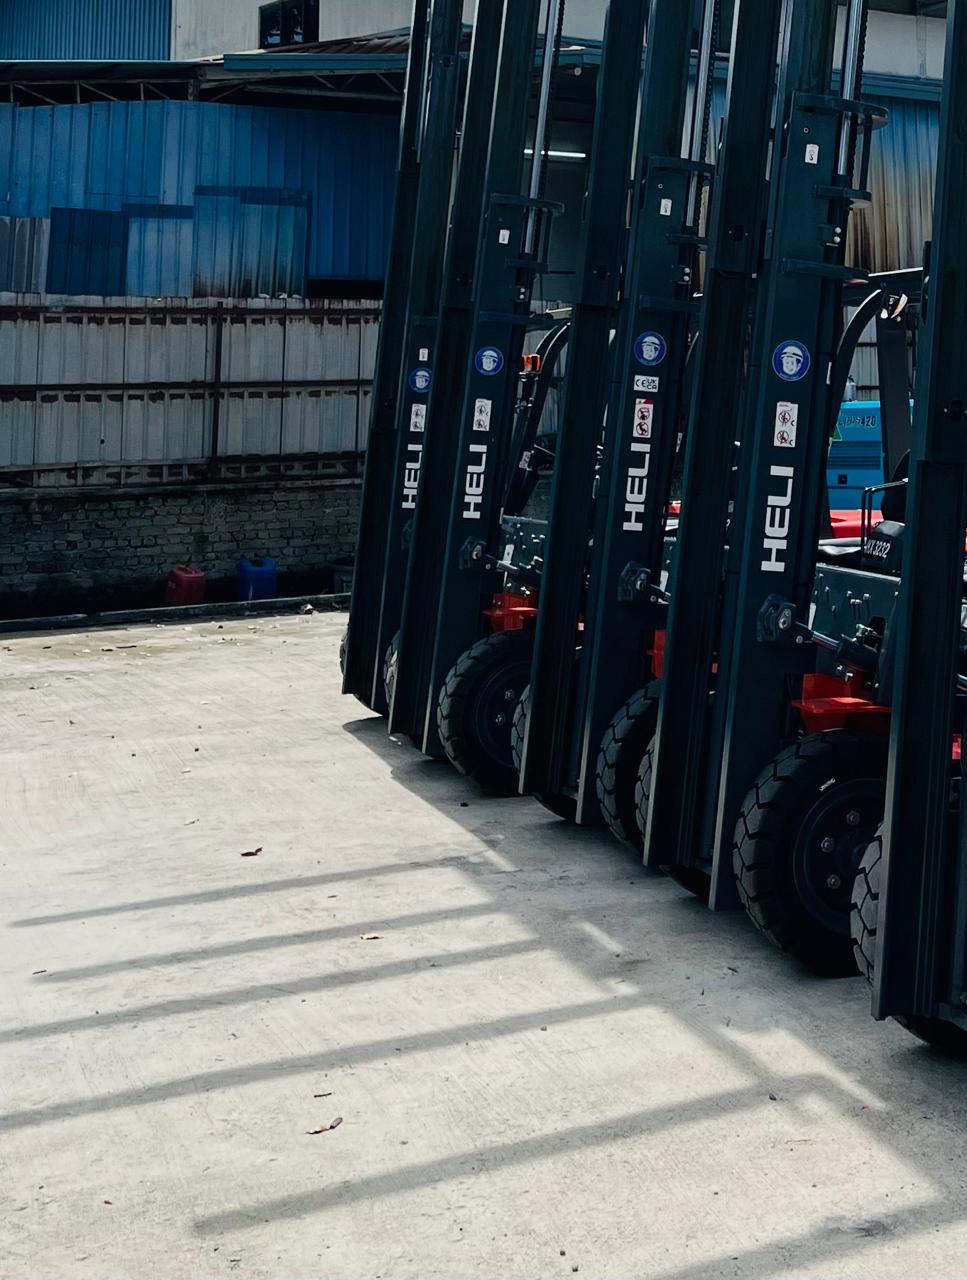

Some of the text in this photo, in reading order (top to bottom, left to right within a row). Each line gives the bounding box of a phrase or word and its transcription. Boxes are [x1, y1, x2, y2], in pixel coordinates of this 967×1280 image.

[402, 444, 423, 509] HELI
[462, 444, 488, 519] HELI
[622, 442, 651, 531] HELI
[760, 465, 794, 572] HELI
